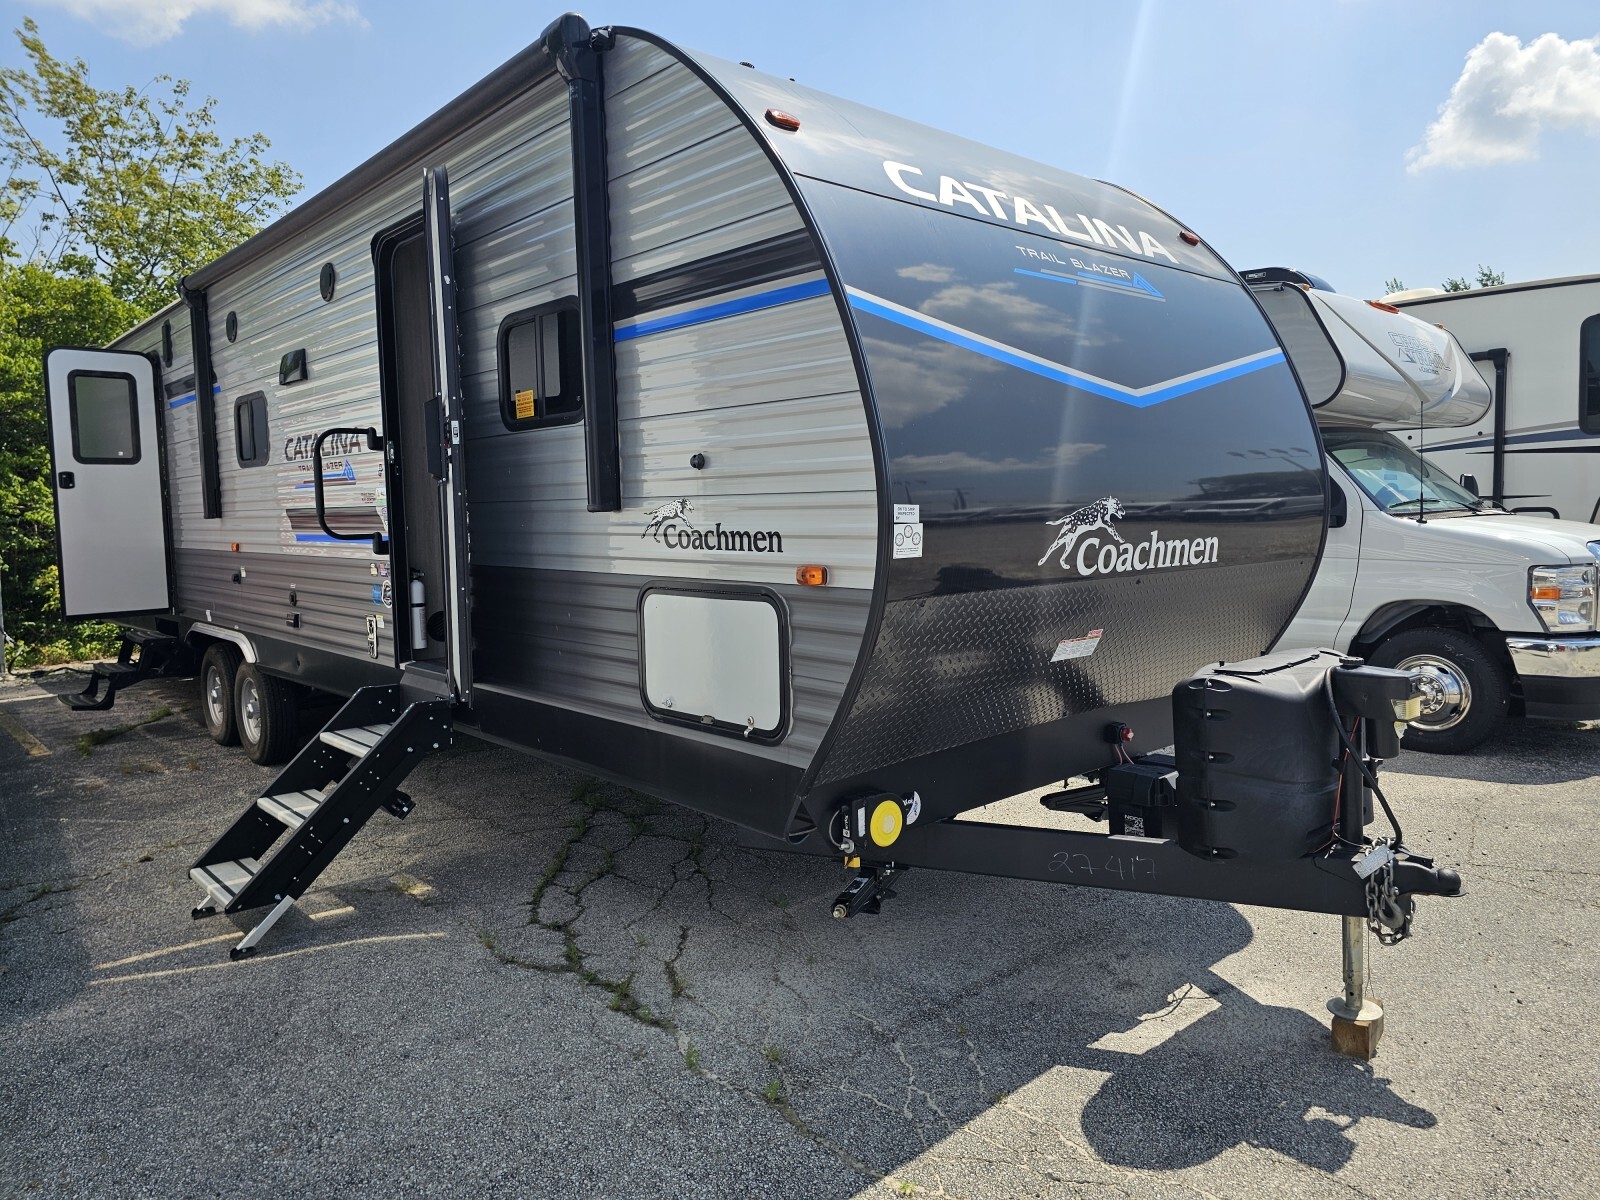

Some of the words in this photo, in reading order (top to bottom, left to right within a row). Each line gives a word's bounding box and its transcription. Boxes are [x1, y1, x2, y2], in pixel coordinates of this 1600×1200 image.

[883, 160, 1180, 264] CATALINA
[1015, 246, 1066, 265] TRAIL
[1070, 258, 1131, 279] BLAZER
[663, 522, 783, 553] Coachmen
[1076, 530, 1219, 576] Coachmen
